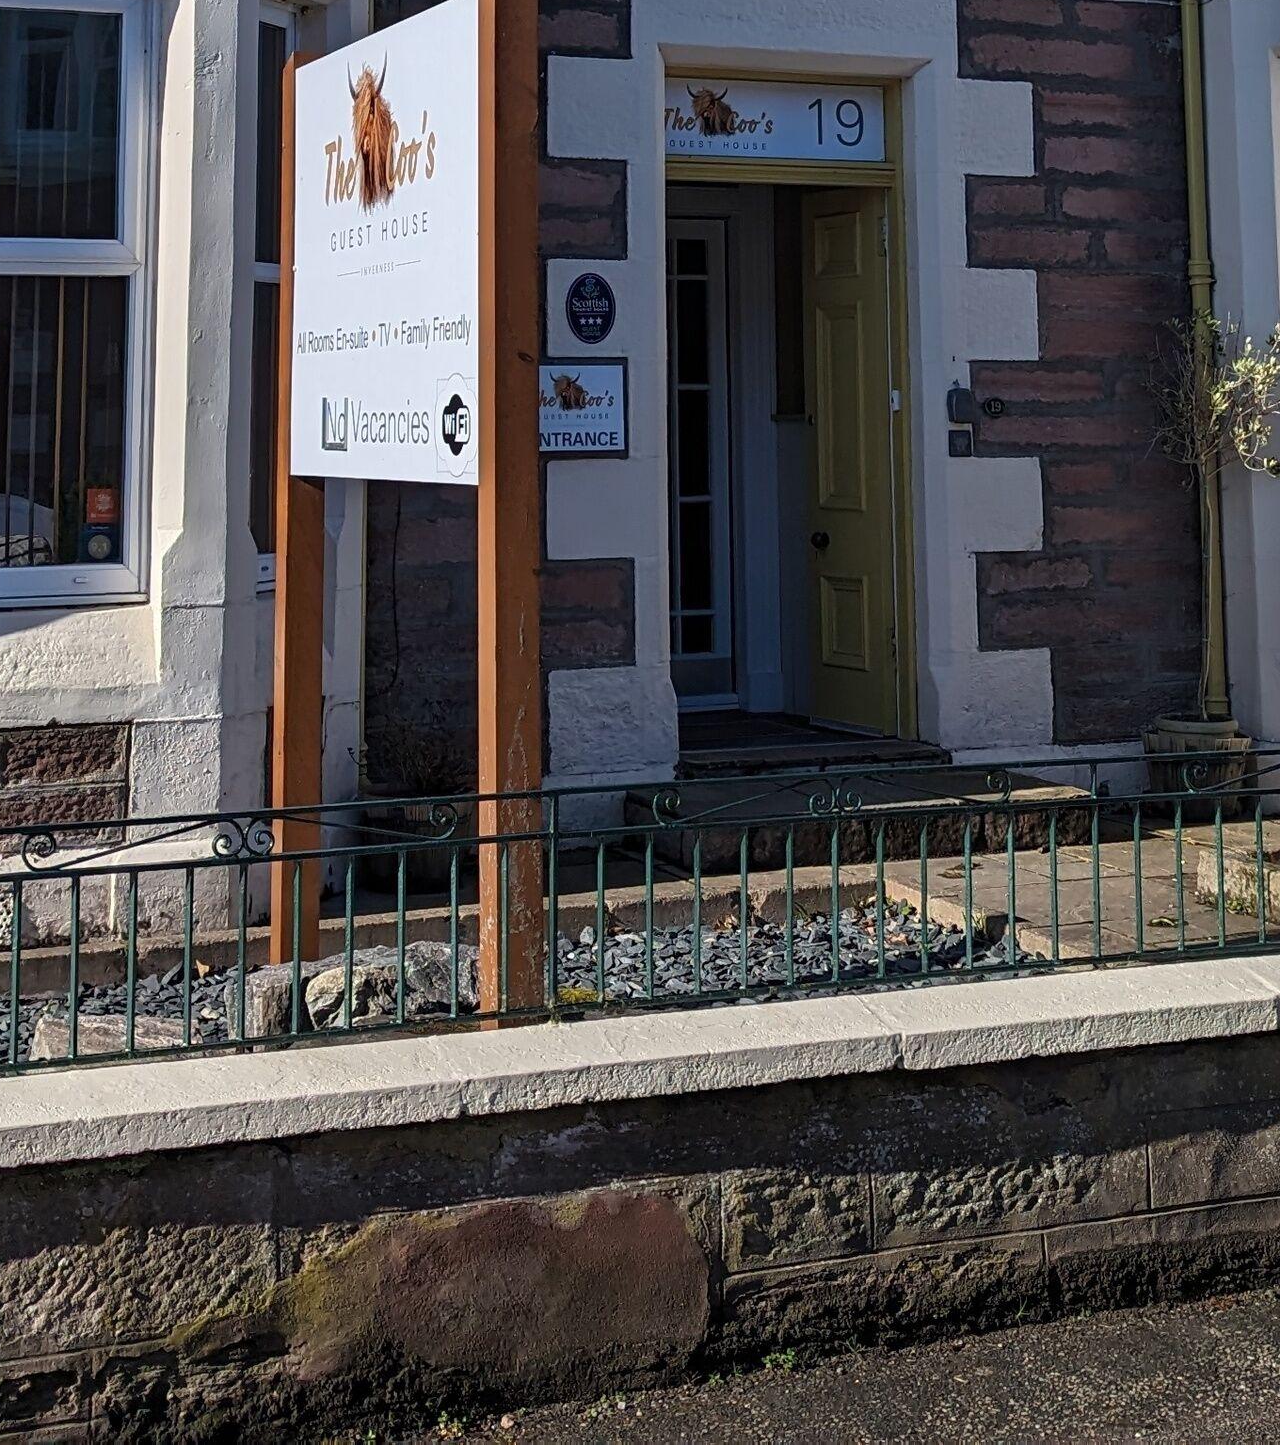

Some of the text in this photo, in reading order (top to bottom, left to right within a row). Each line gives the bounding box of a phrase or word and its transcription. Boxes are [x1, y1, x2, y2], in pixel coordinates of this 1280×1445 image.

[664, 106, 697, 132] The
[807, 98, 864, 147] 19
[669, 139, 767, 151] GUEST HOUSE
[324, 110, 437, 207] The Coo's
[330, 211, 429, 253] GUEST HOUSE
[360, 261, 395, 277] INVERNESS
[572, 297, 609, 308] Scottish
[296, 313, 472, 355] All Rooms En-suite TV Family Friendly
[539, 389, 557, 407] he
[351, 399, 430, 444] Vacancies
[539, 431, 619, 447] NTRANCE
